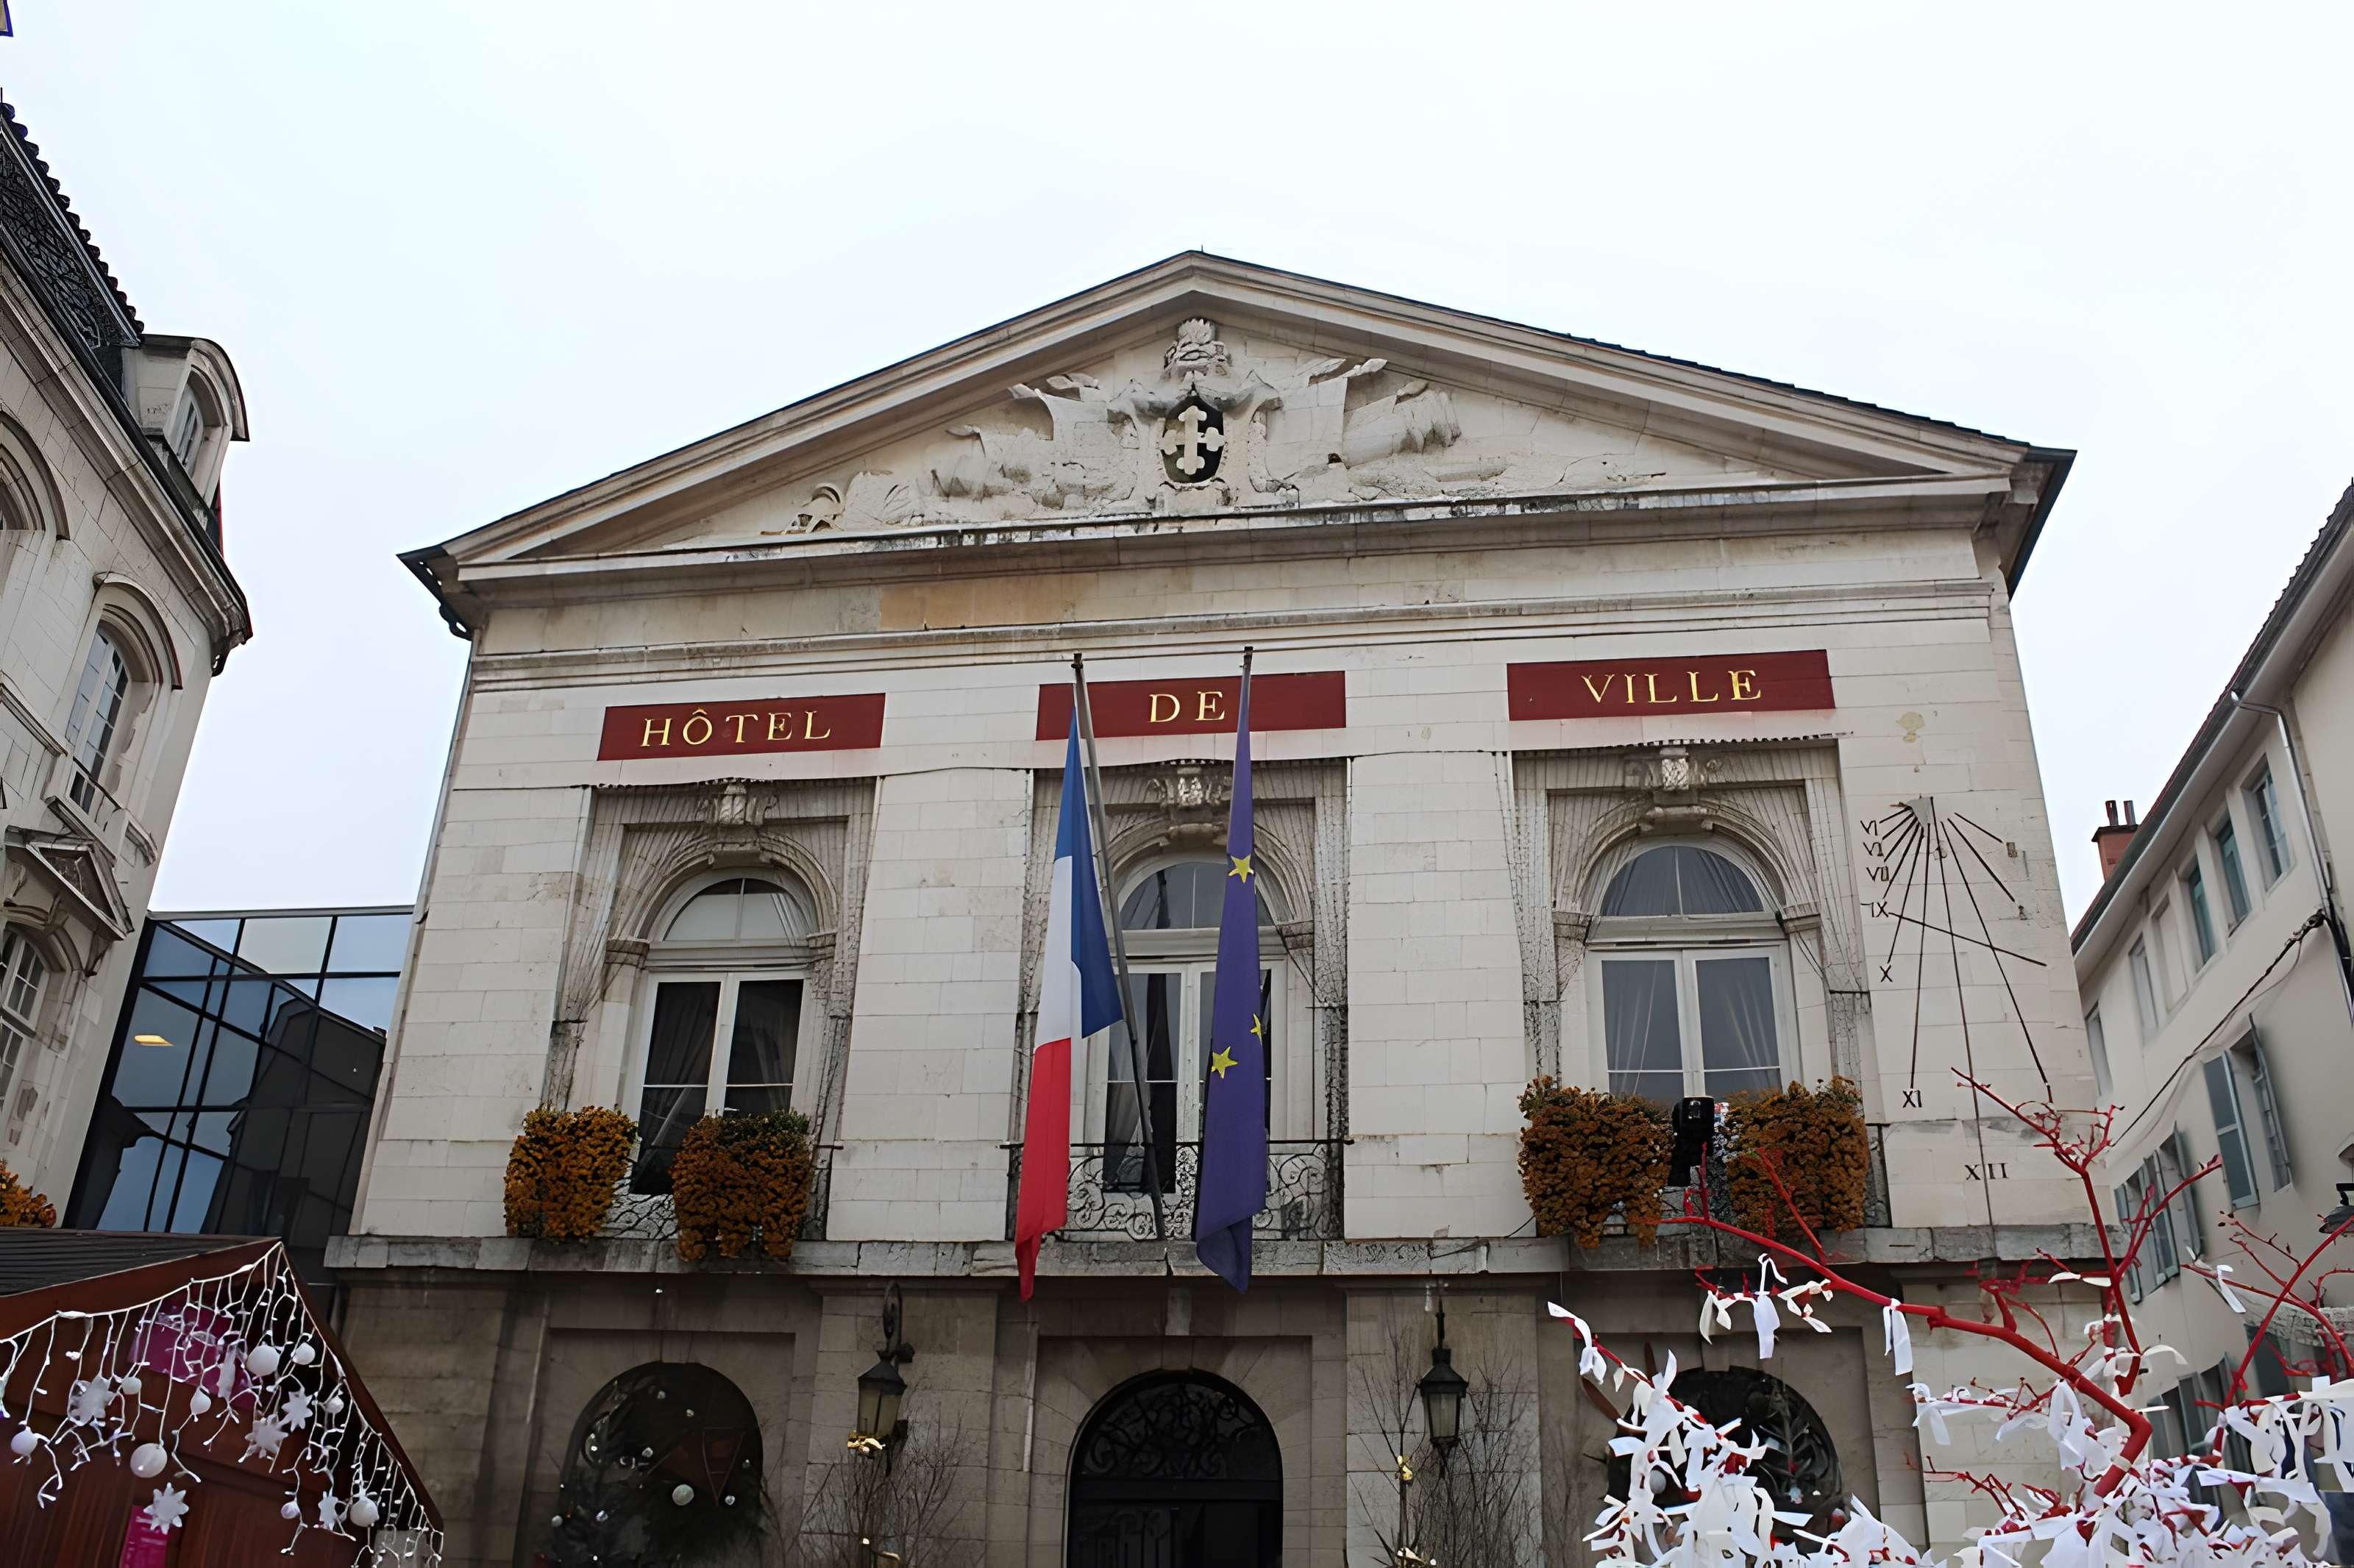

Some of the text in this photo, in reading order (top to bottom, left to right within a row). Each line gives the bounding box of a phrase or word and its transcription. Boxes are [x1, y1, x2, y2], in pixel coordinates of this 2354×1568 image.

[640, 669, 1762, 747] HÔTEL DE VILLE
[1880, 964, 1893, 983] X
[1902, 1089, 1923, 1108] XI
[1964, 1162, 2009, 1181] XII
